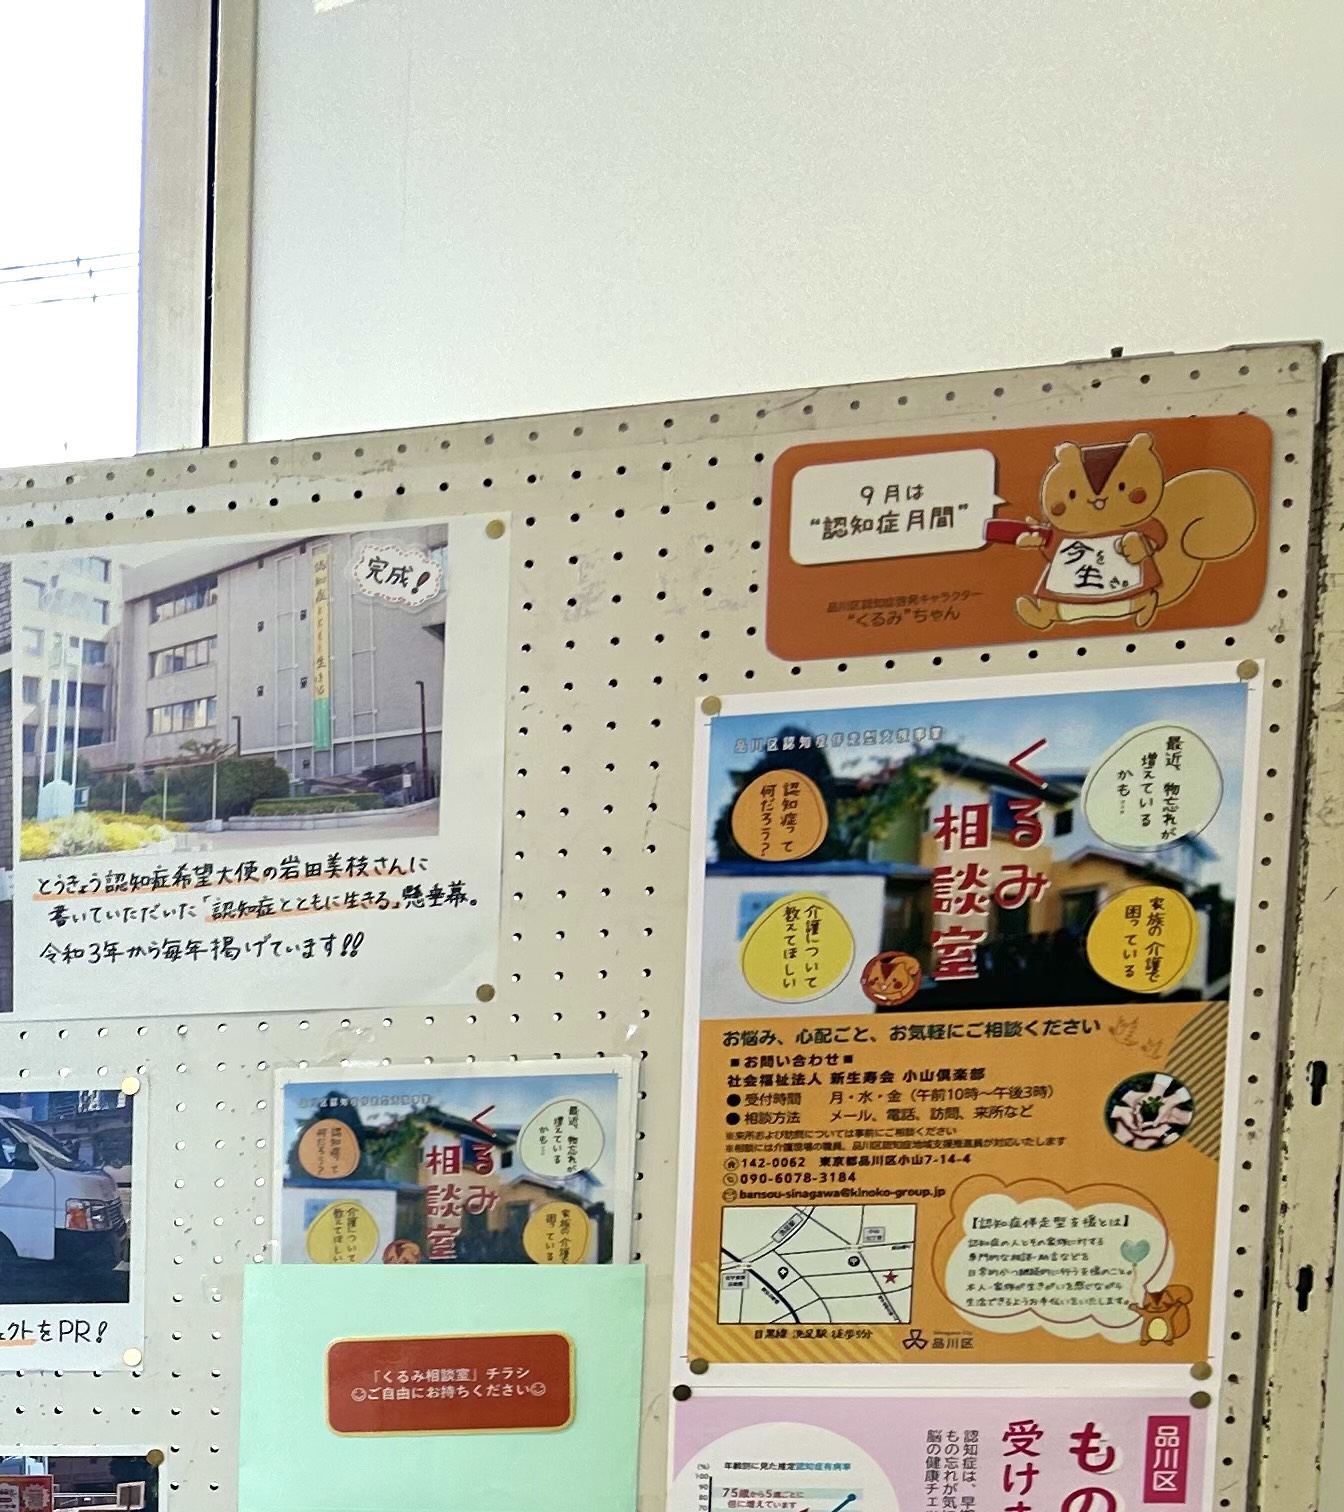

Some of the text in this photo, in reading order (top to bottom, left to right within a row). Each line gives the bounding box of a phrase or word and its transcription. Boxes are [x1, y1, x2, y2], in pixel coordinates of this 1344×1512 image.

[858, 483, 925, 505] 9月は
[366, 556, 431, 594] 完成！
[1139, 752, 1156, 828] 増えている
[760, 783, 779, 857] 何だろう？
[992, 736, 1051, 910] くるみ
[931, 801, 992, 982] 相談室
[803, 904, 822, 990] 介護について
[1123, 905, 1141, 979] 困っている
[722, 1019, 1101, 1047] お悩み、心配ごと、お気軽にご相談ください
[744, 1053, 840, 1070] お問い合わせ
[727, 1067, 986, 1088] 社会福祉法人 新生寿会 小山倶楽部
[744, 1092, 802, 1107] 受付時間
[744, 1104, 1034, 1125] 相談方法 メール、電話、訪問、来所など
[739, 1171, 856, 1185] 090-6078-3184
[426, 1144, 461, 1261] 相談室
[932, 1338, 974, 1349] 品川区
[485, 1365, 532, 1381] チラシ
[366, 1382, 533, 1401] ご自由にお持ちください
[1152, 1425, 1181, 1493] 品川区
